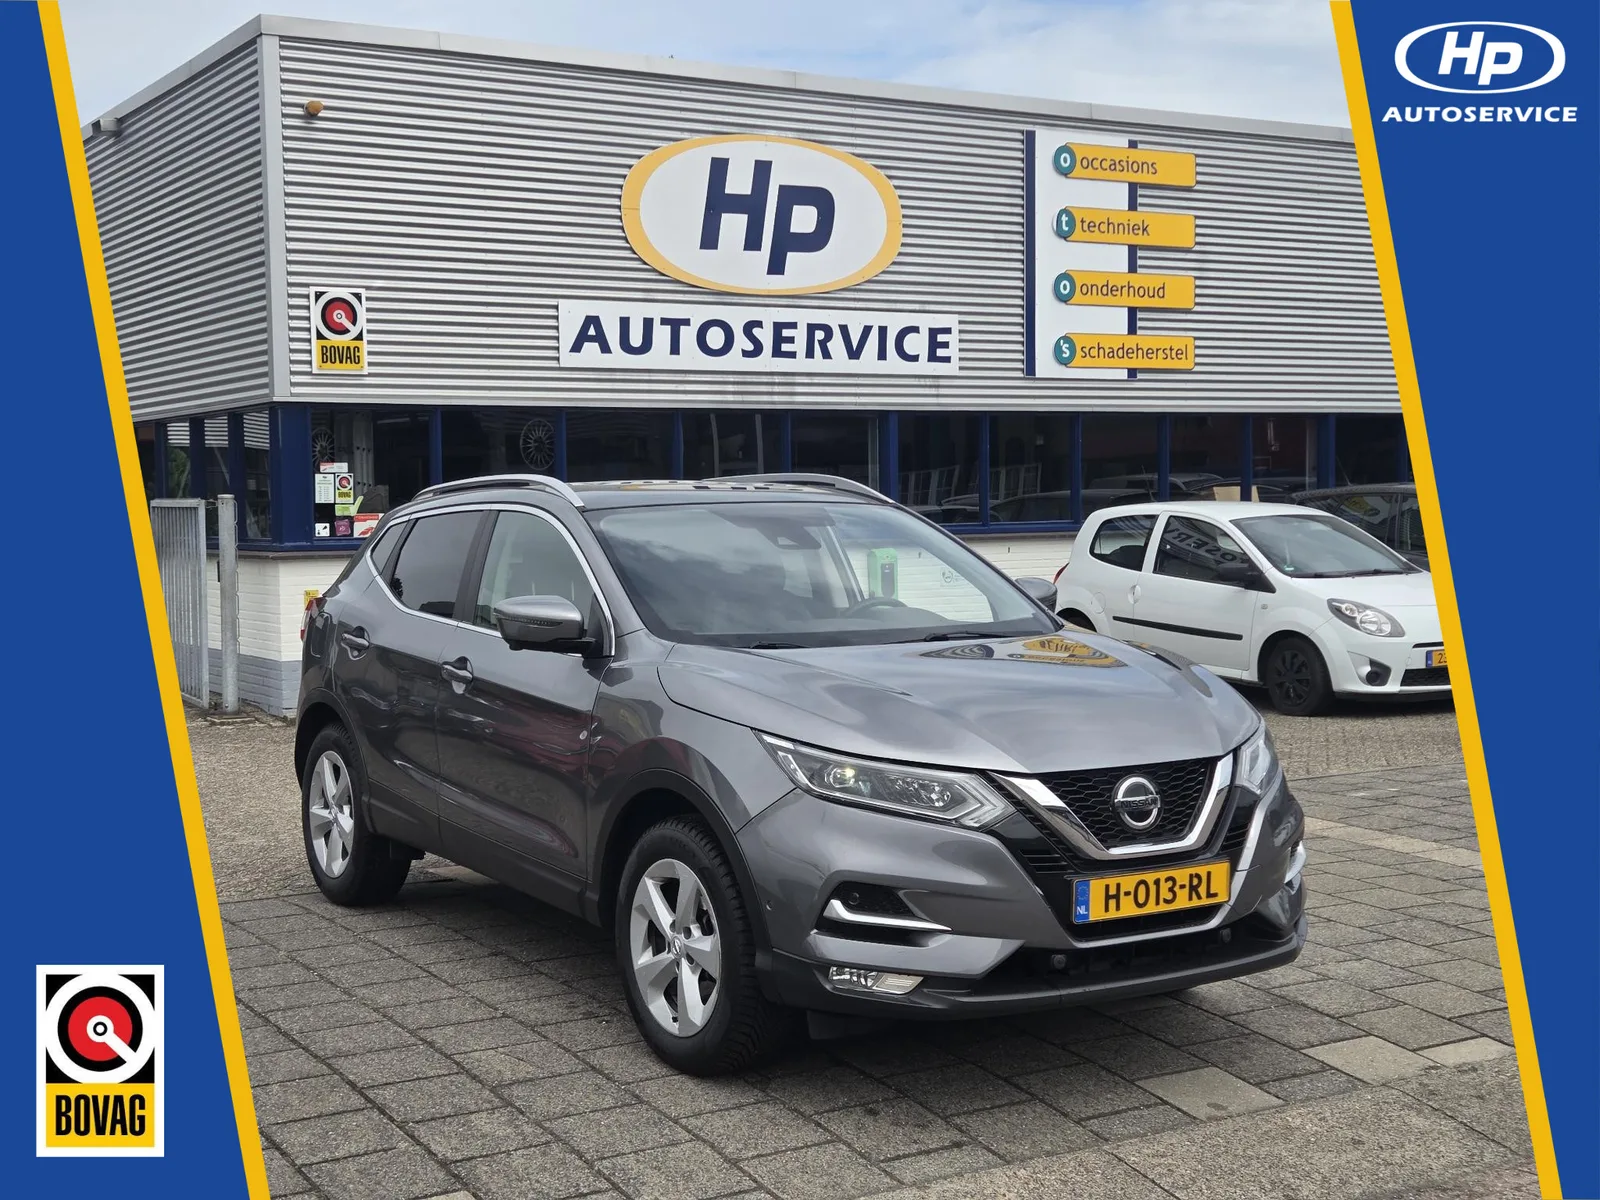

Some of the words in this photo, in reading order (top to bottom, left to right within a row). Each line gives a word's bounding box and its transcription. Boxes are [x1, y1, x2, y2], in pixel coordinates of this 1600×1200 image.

[1080, 156, 1158, 175] occasions
[699, 157, 835, 275] Hp
[1080, 217, 1150, 236] techniek
[1080, 280, 1166, 299] onderhoud
[569, 315, 953, 364] AUTOSERVICE
[321, 345, 361, 365] BOVAG
[1080, 341, 1188, 361] schadeherstel
[1120, 797, 1158, 809] NISSAN
[1104, 871, 1219, 913] H-013-RL
[1076, 905, 1088, 915] NL
